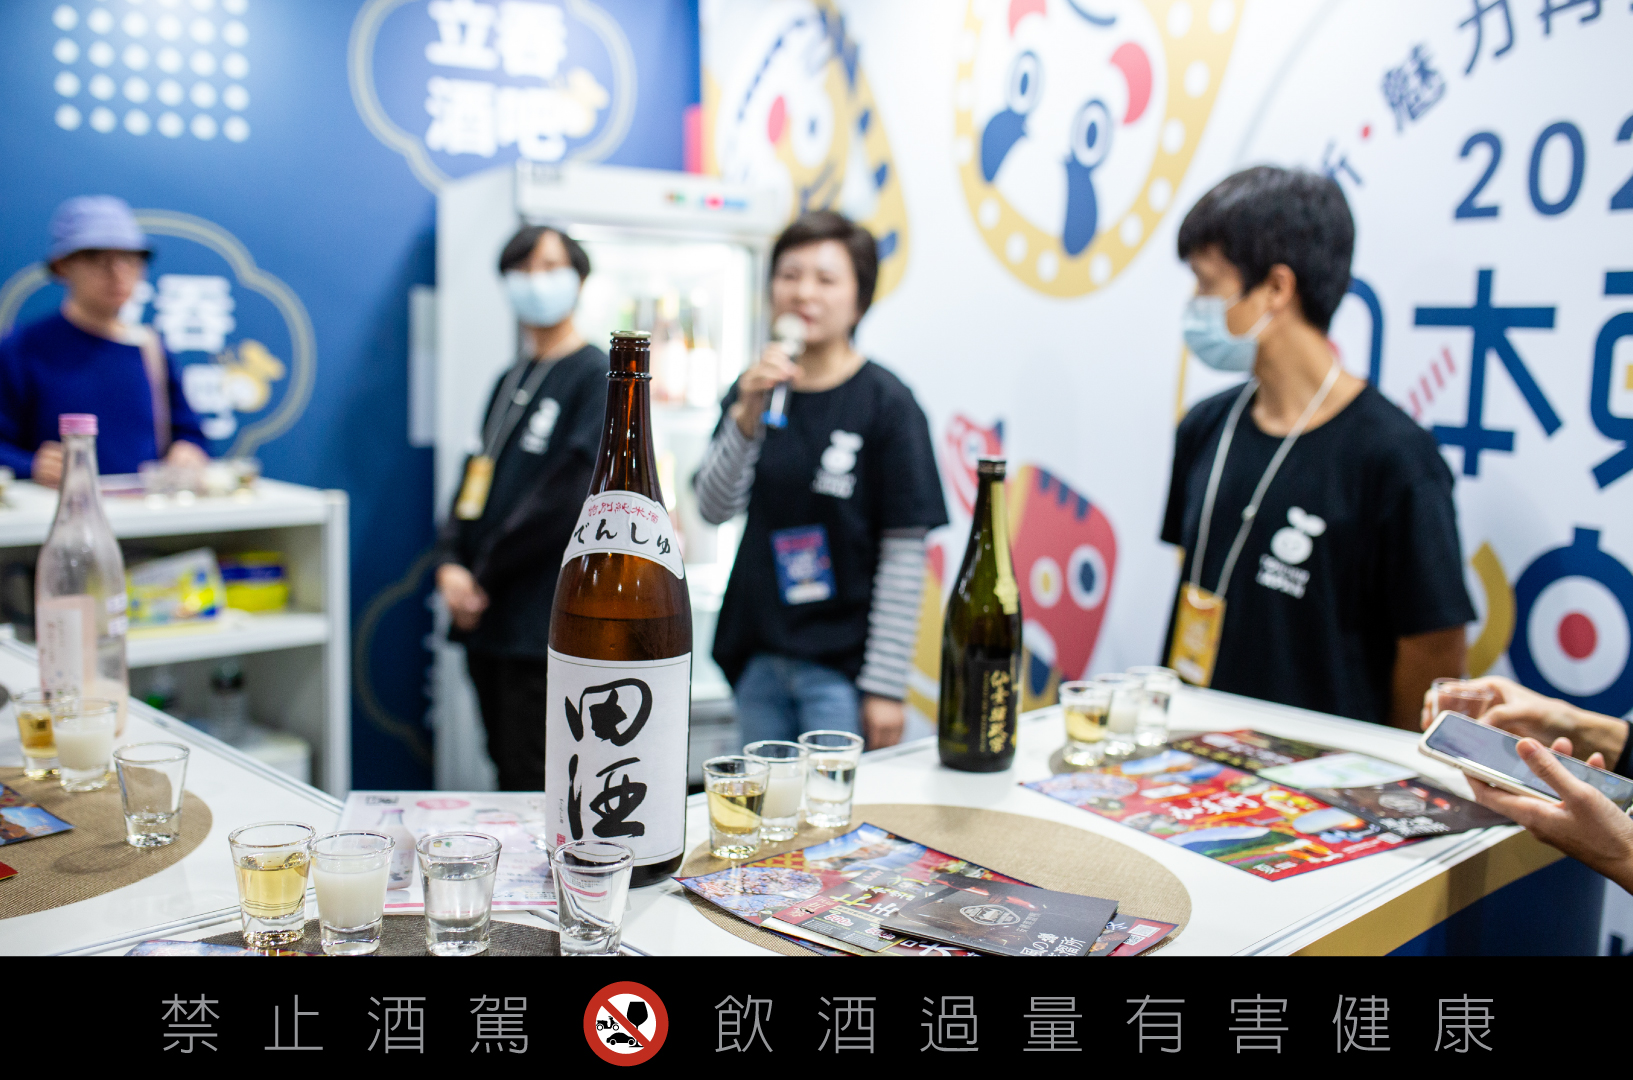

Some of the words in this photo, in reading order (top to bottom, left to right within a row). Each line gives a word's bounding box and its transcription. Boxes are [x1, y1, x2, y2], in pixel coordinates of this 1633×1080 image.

[573, 518, 671, 555] でんしゅ
[564, 677, 653, 839] 田酒
